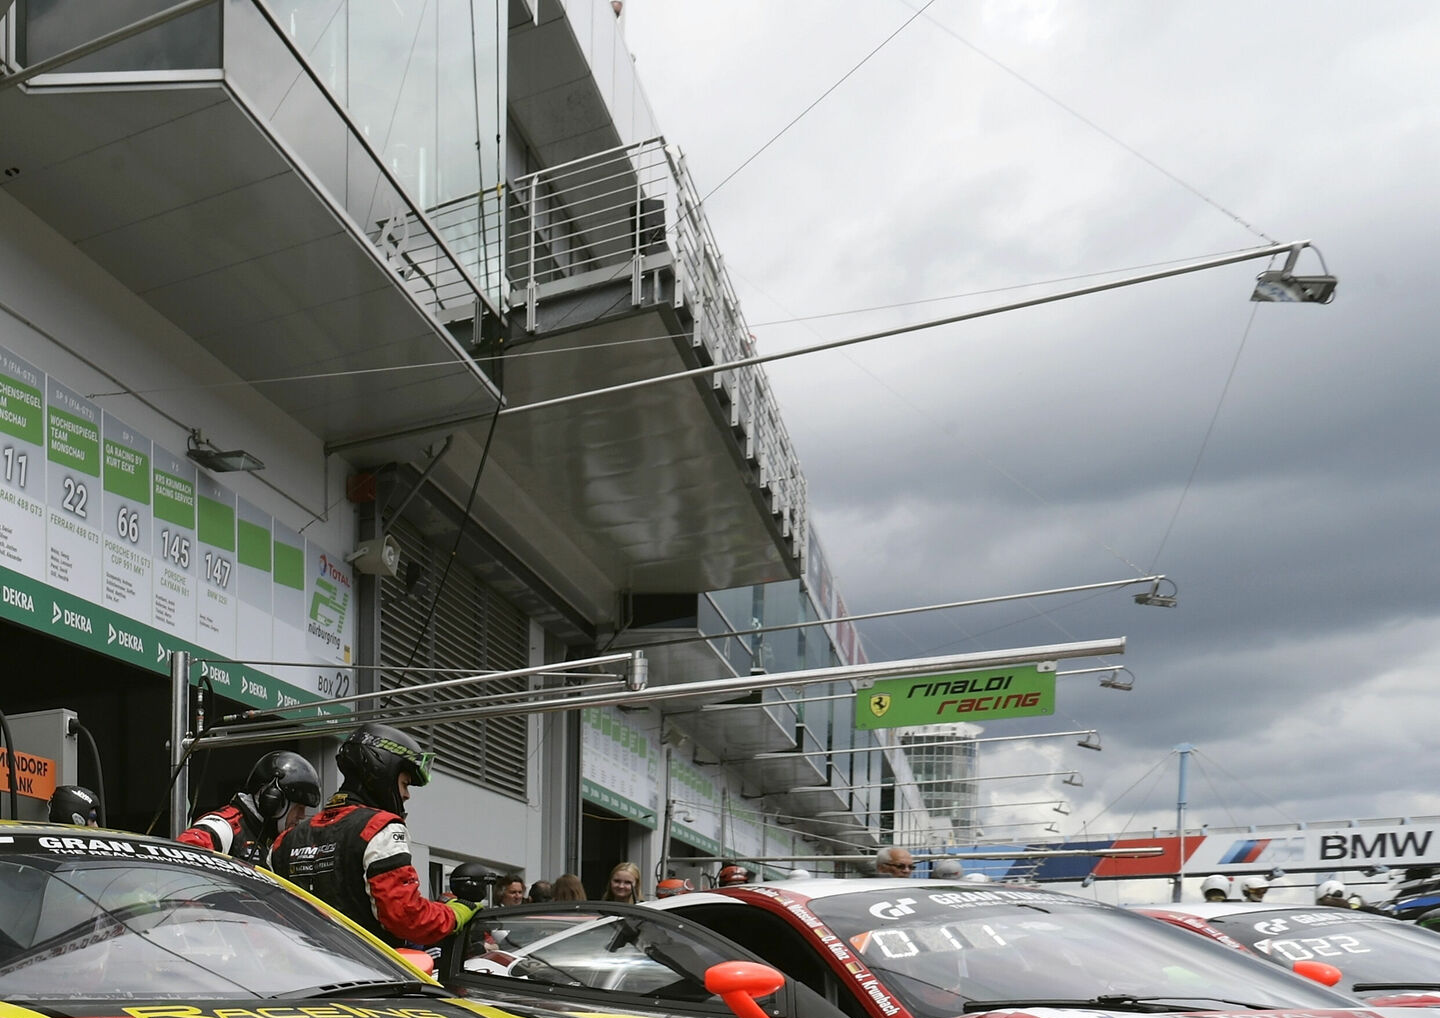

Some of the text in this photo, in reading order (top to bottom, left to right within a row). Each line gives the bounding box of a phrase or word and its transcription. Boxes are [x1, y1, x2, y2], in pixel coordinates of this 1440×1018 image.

[50, 415, 98, 442] WOCHENSPIEGEL
[51, 427, 68, 442] TEAM
[51, 440, 86, 461] MONSCHAU
[4, 448, 27, 488] 11
[17, 498, 29, 511] 488
[30, 504, 43, 517] GT3
[62, 477, 89, 518] 22
[50, 513, 76, 533] FERRARI
[118, 508, 139, 543] 66
[162, 530, 190, 569] 145
[205, 553, 231, 588] 147
[328, 564, 350, 588] TOTAL
[3, 586, 34, 612] DEKRA
[64, 609, 93, 634] DEKRA
[118, 630, 144, 653] DEKRA
[308, 623, 341, 650] nürburgring
[210, 668, 230, 686] DEKRA
[318, 671, 350, 699] BOX 22
[249, 681, 268, 700] DEKRA
[38, 836, 135, 853] GRAN
[1320, 830, 1433, 861] BMW
[88, 850, 134, 859] REAL
[136, 853, 202, 867] DRIVING
[928, 890, 997, 905] GRAN
[828, 942, 850, 960] Kainz
[1271, 934, 1371, 961] 022
[855, 973, 900, 1017] J. Krumbach
